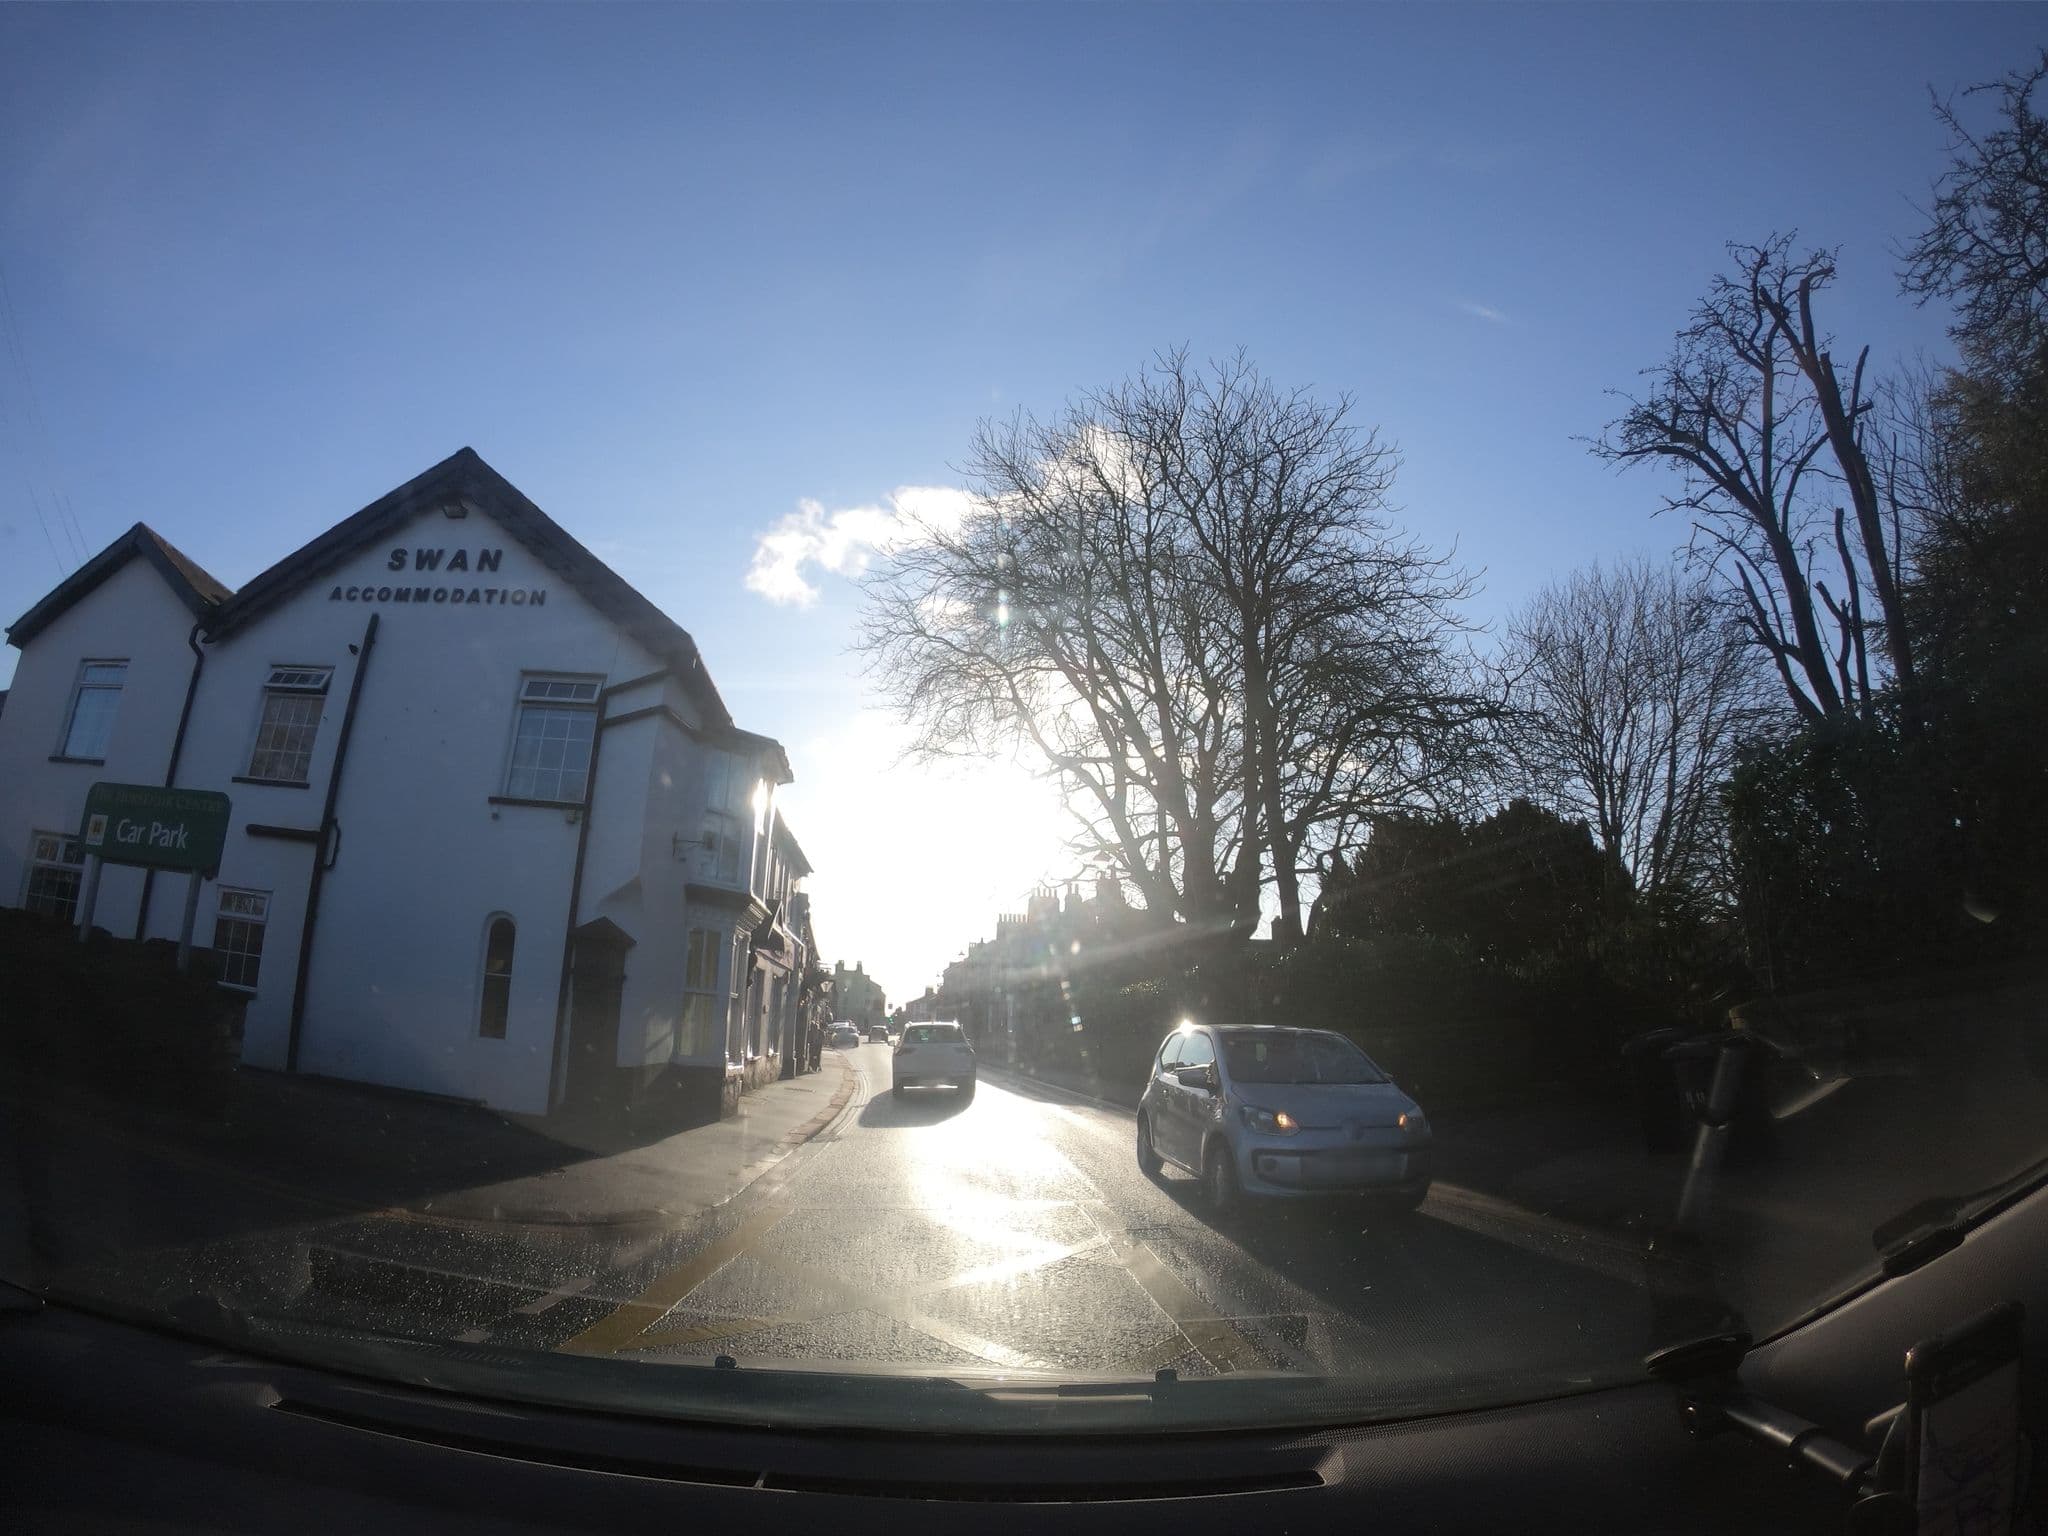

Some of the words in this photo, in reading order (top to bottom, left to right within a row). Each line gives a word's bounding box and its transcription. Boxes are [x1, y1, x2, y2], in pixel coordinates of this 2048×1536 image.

[388, 548, 503, 572] SWAN
[328, 586, 547, 606] ACCOMMODATION
[116, 818, 146, 844] Car
[149, 821, 189, 849] Park
